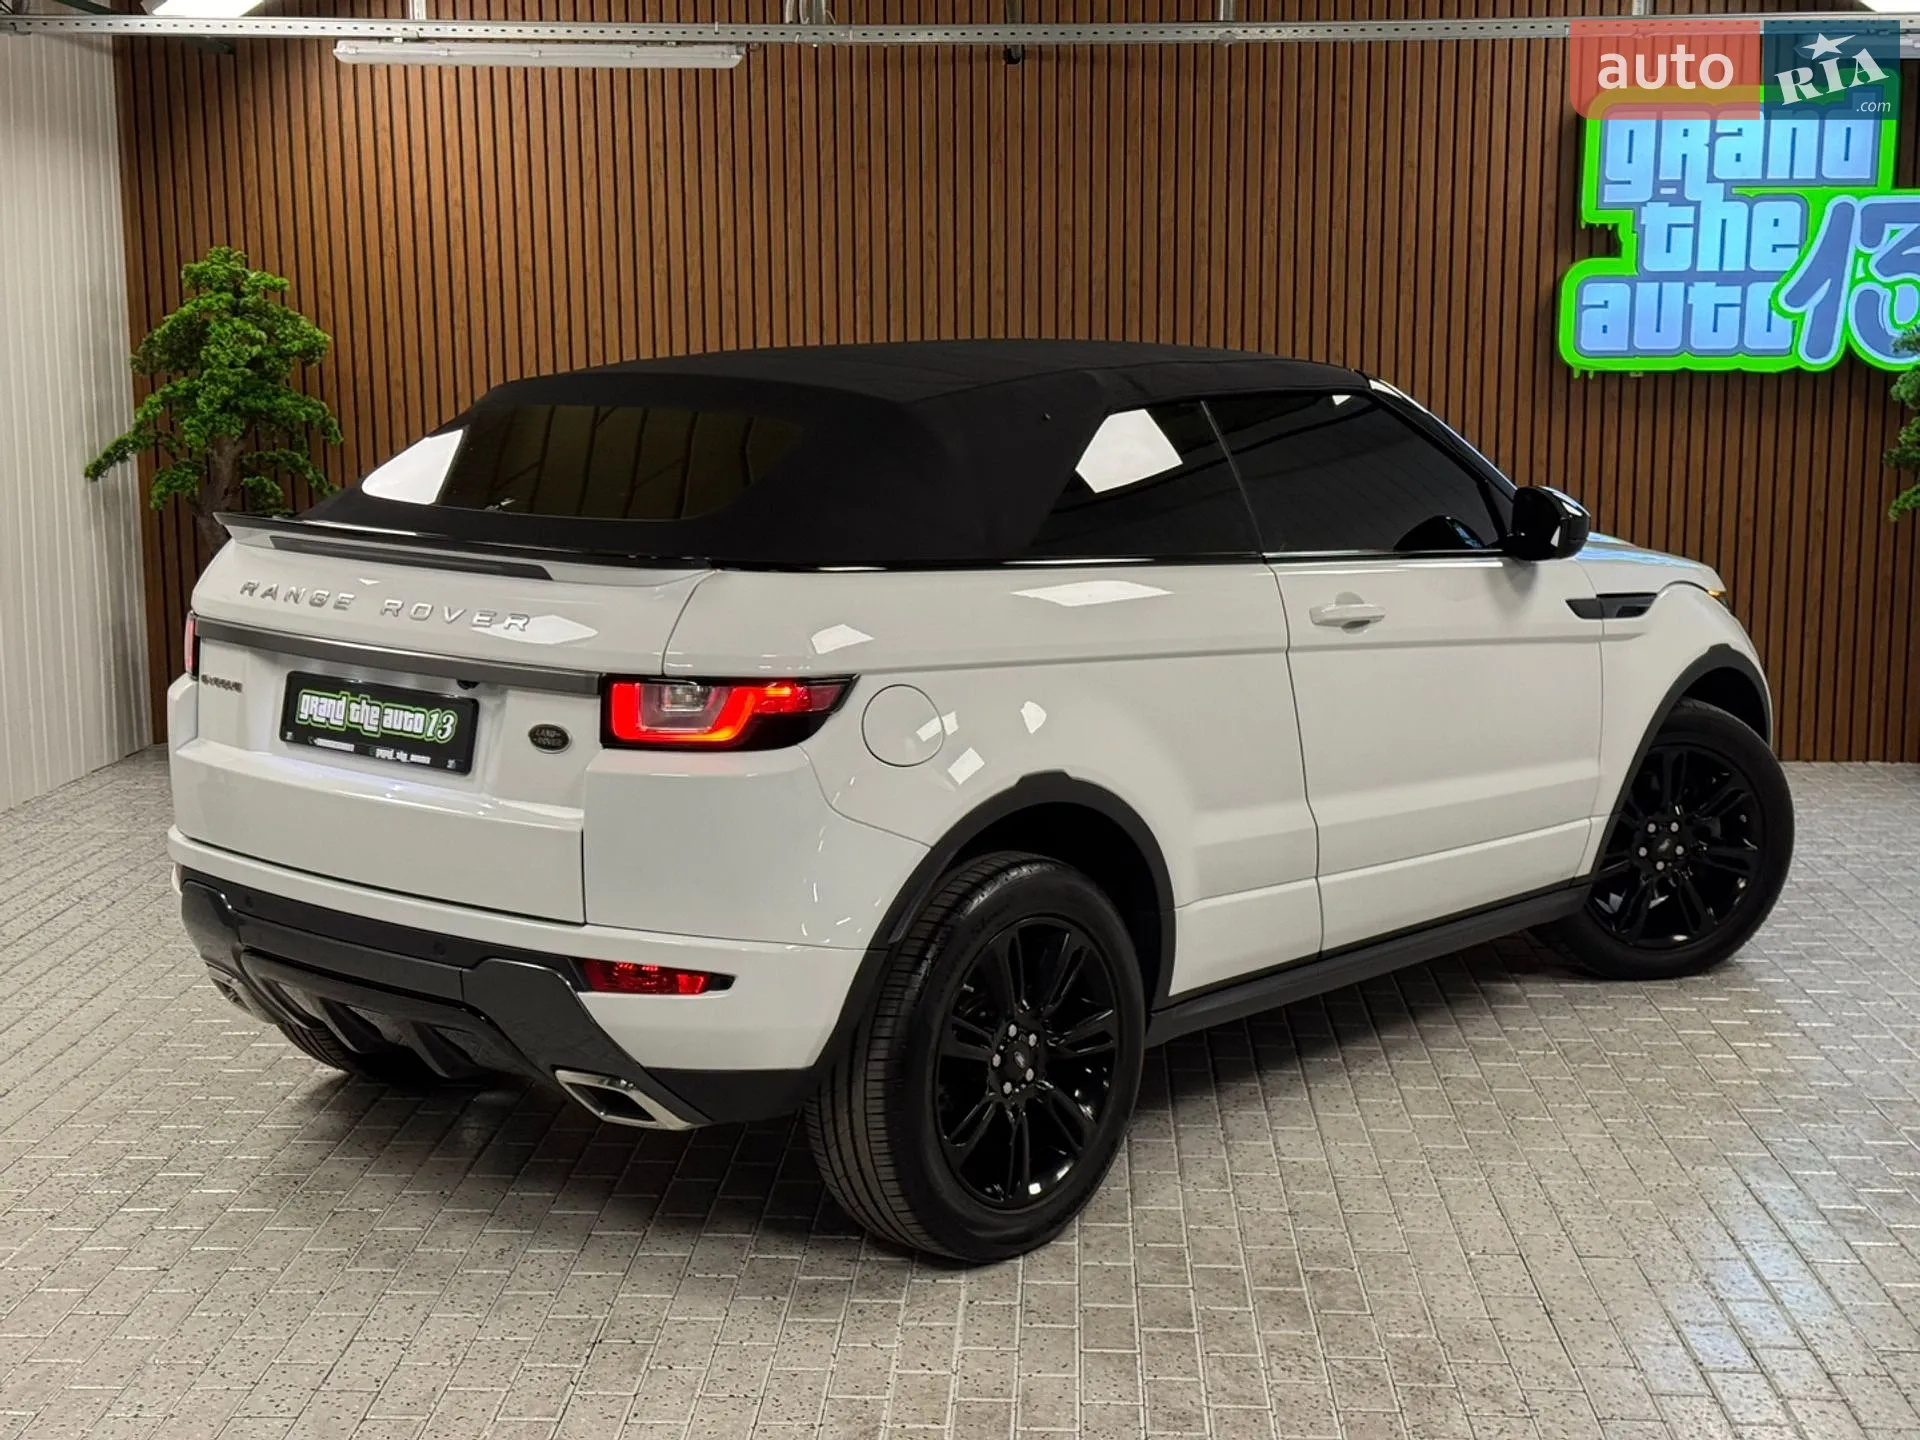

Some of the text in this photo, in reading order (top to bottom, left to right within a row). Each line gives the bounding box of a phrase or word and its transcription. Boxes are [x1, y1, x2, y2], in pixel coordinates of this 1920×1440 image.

[1641, 183, 1803, 272] the
[1580, 281, 1796, 351] auto
[239, 579, 531, 632] RANGE ROVER
[349, 697, 381, 732] the
[382, 706, 425, 734] auto
[426, 708, 456, 741] 13
